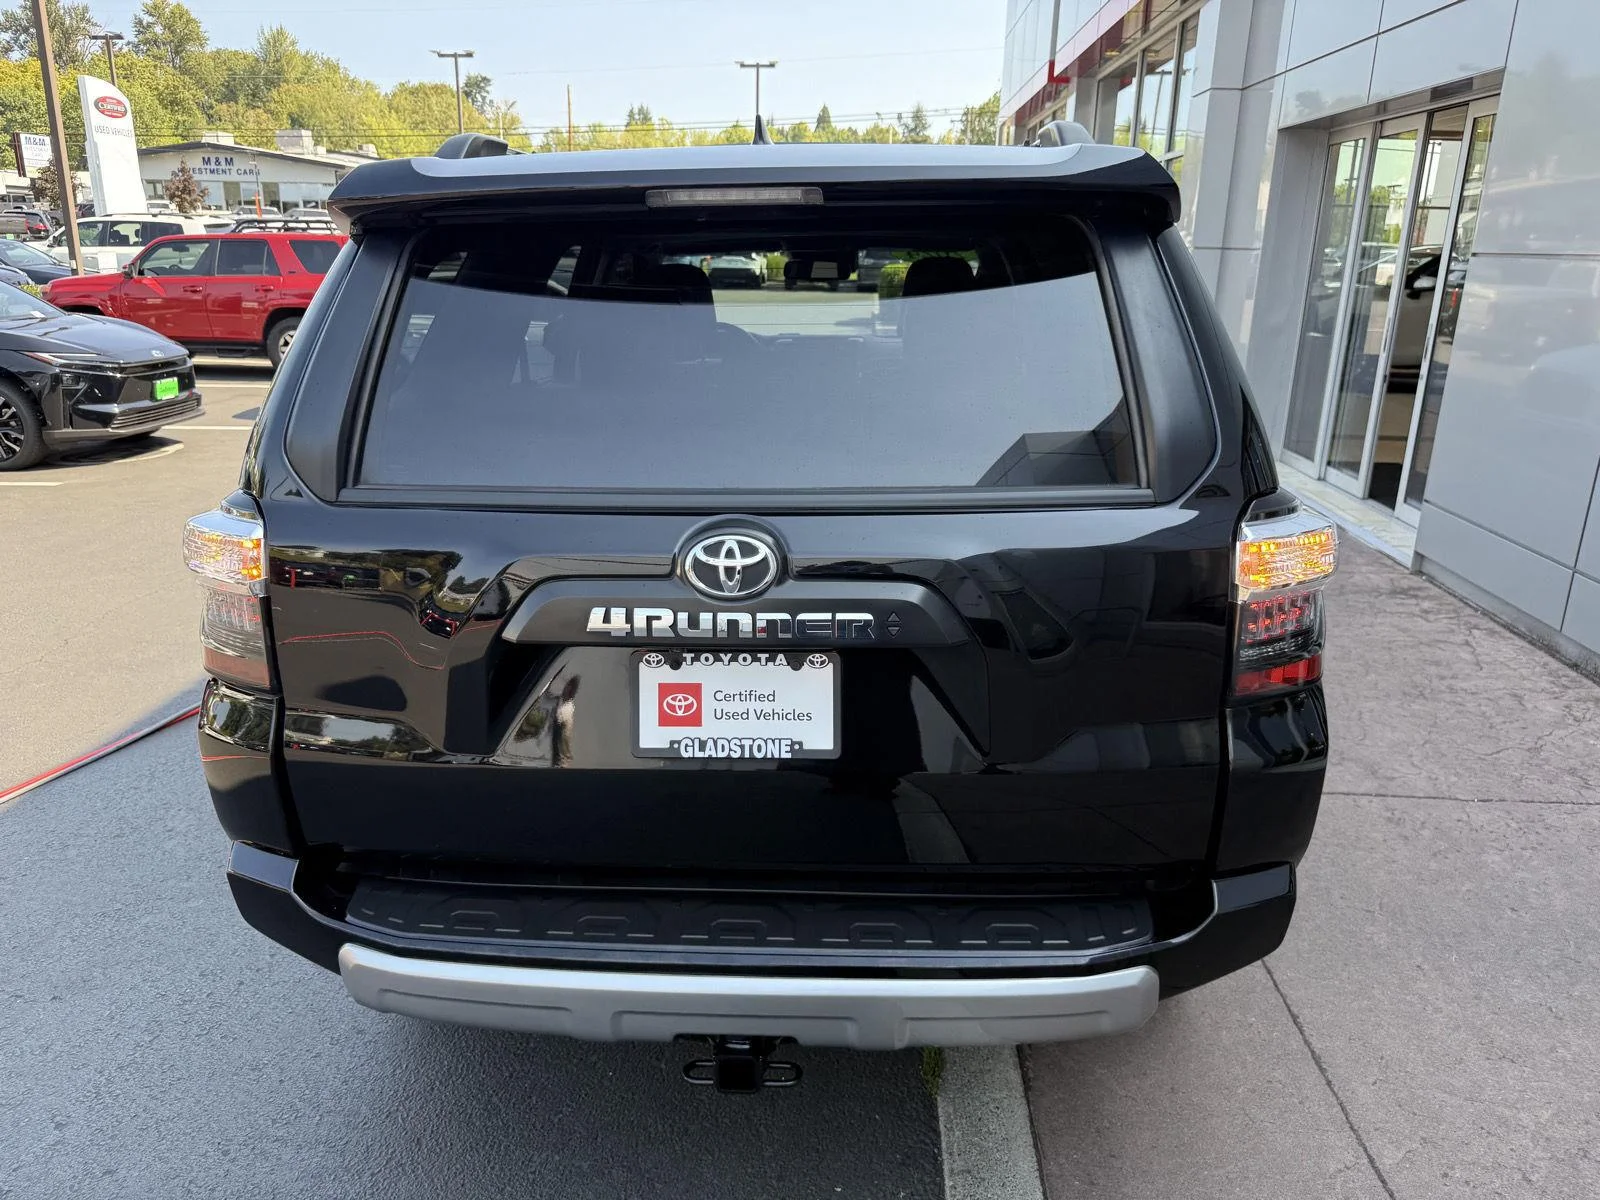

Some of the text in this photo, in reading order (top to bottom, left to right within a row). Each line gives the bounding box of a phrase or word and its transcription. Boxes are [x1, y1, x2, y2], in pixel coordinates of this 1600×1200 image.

[202, 156, 234, 167] M & M
[178, 167, 233, 176] IESTMENT
[586, 607, 876, 640] 4RUNNER
[682, 652, 788, 667] TOYOTA
[713, 690, 776, 702] Certified
[713, 708, 813, 721] Used Vehicles
[679, 737, 793, 759] GLADSTONE
